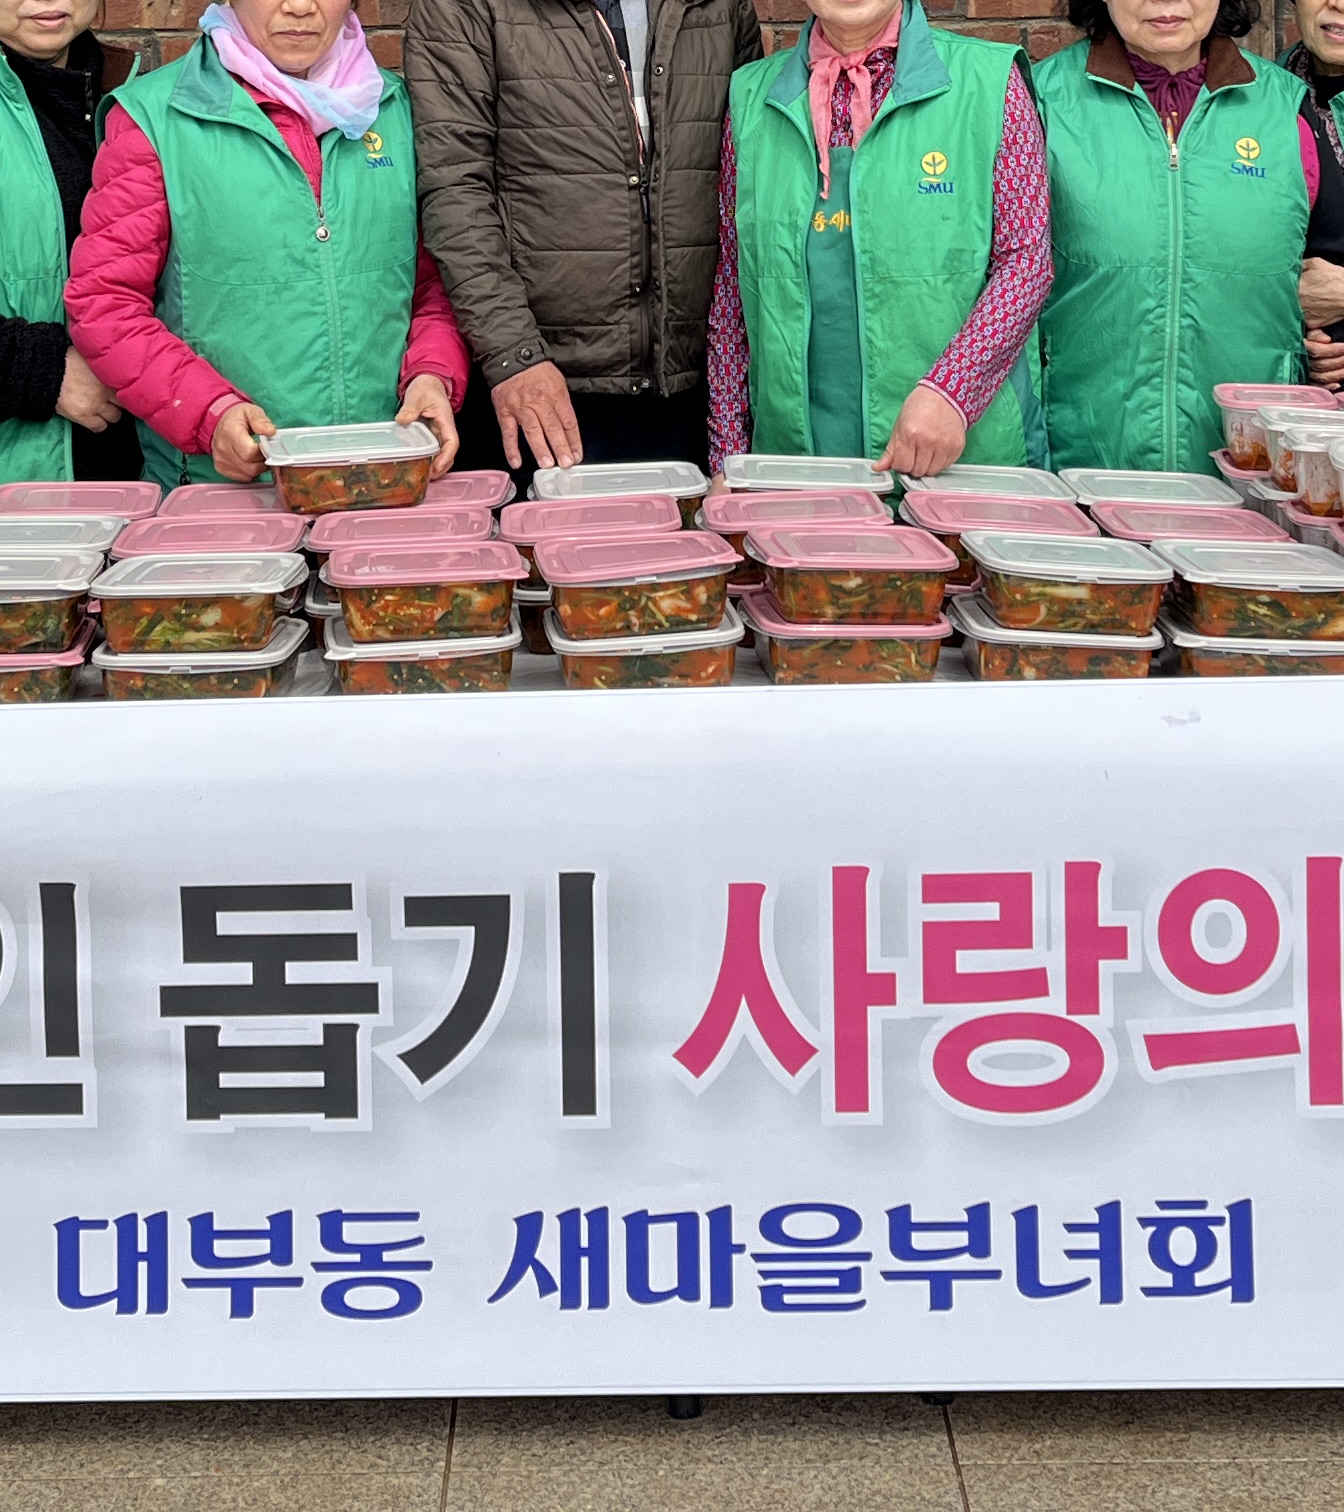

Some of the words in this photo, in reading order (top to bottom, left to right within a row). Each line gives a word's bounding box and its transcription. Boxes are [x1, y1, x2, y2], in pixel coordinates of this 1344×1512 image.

[917, 181, 955, 195] SMU
[1230, 161, 1266, 178] SMU
[159, 872, 596, 1120] 돕기
[674, 856, 1344, 1113] 사랑의
[55, 1209, 433, 1319] 대부동
[489, 1199, 1255, 1312] 새마을부녀회
